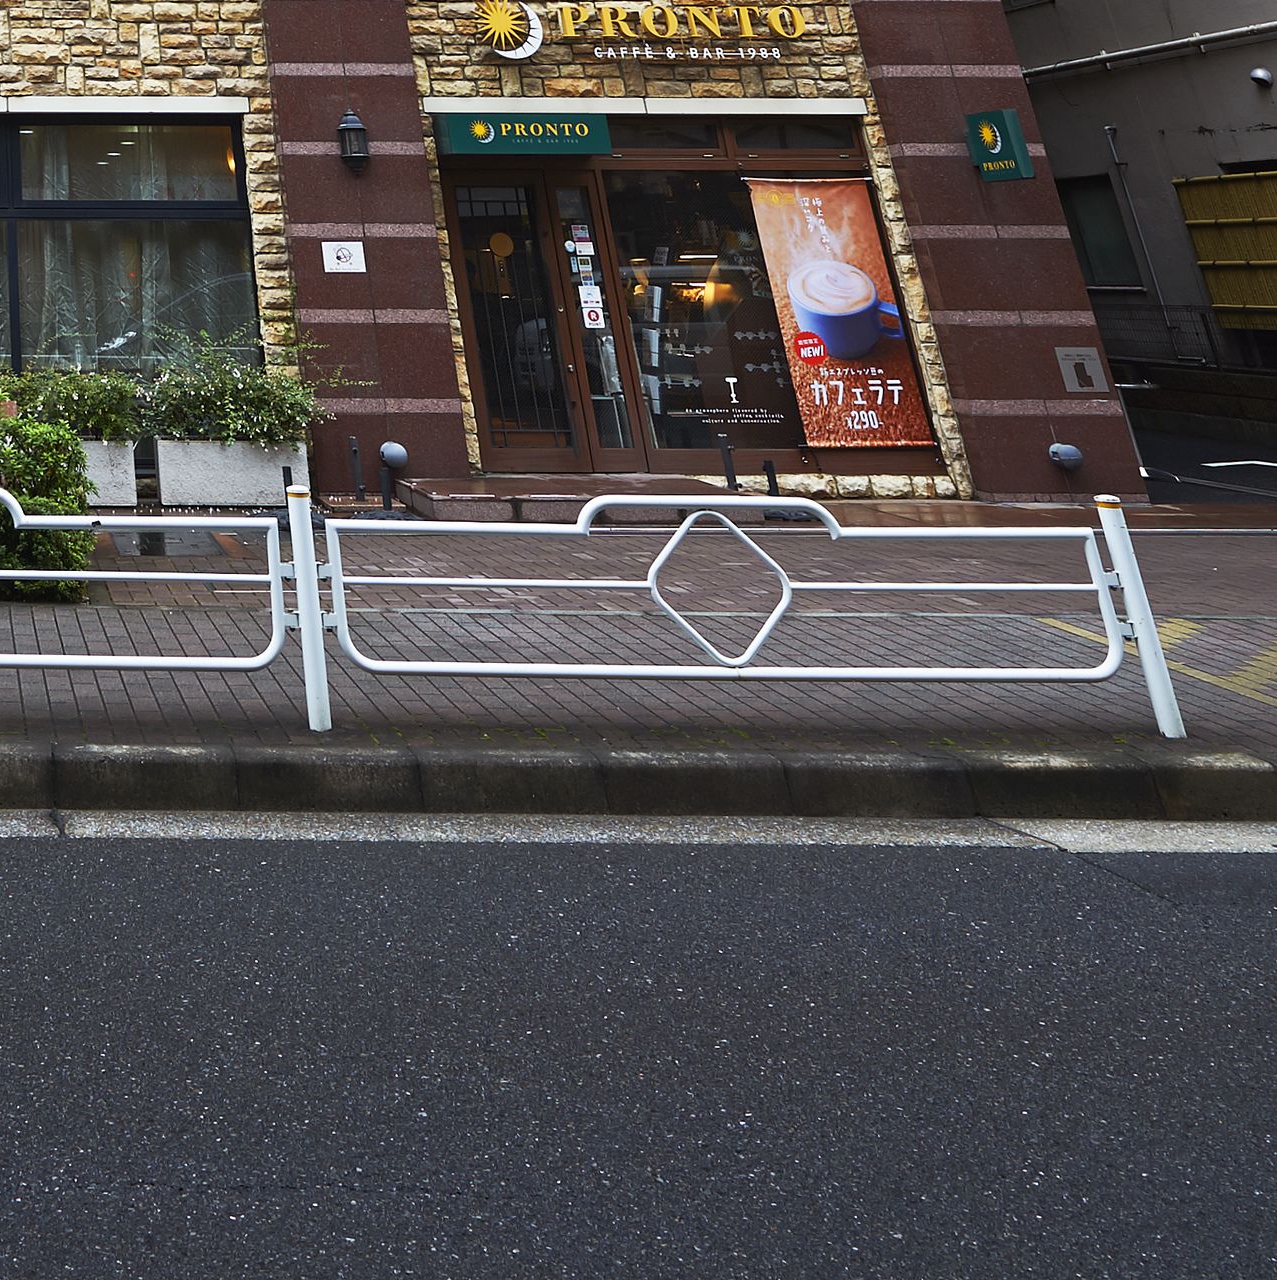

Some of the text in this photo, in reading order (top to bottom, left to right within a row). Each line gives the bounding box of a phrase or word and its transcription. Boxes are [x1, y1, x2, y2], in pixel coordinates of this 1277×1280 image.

[558, 4, 807, 39] PRONTO
[665, 47, 677, 59] &
[689, 47, 726, 59] BAR
[738, 47, 782, 59] 1988
[500, 122, 589, 137] PRONTO
[982, 159, 1016, 172] PRONTO
[800, 344, 824, 358] NEW!
[810, 379, 903, 407] カフェラテ
